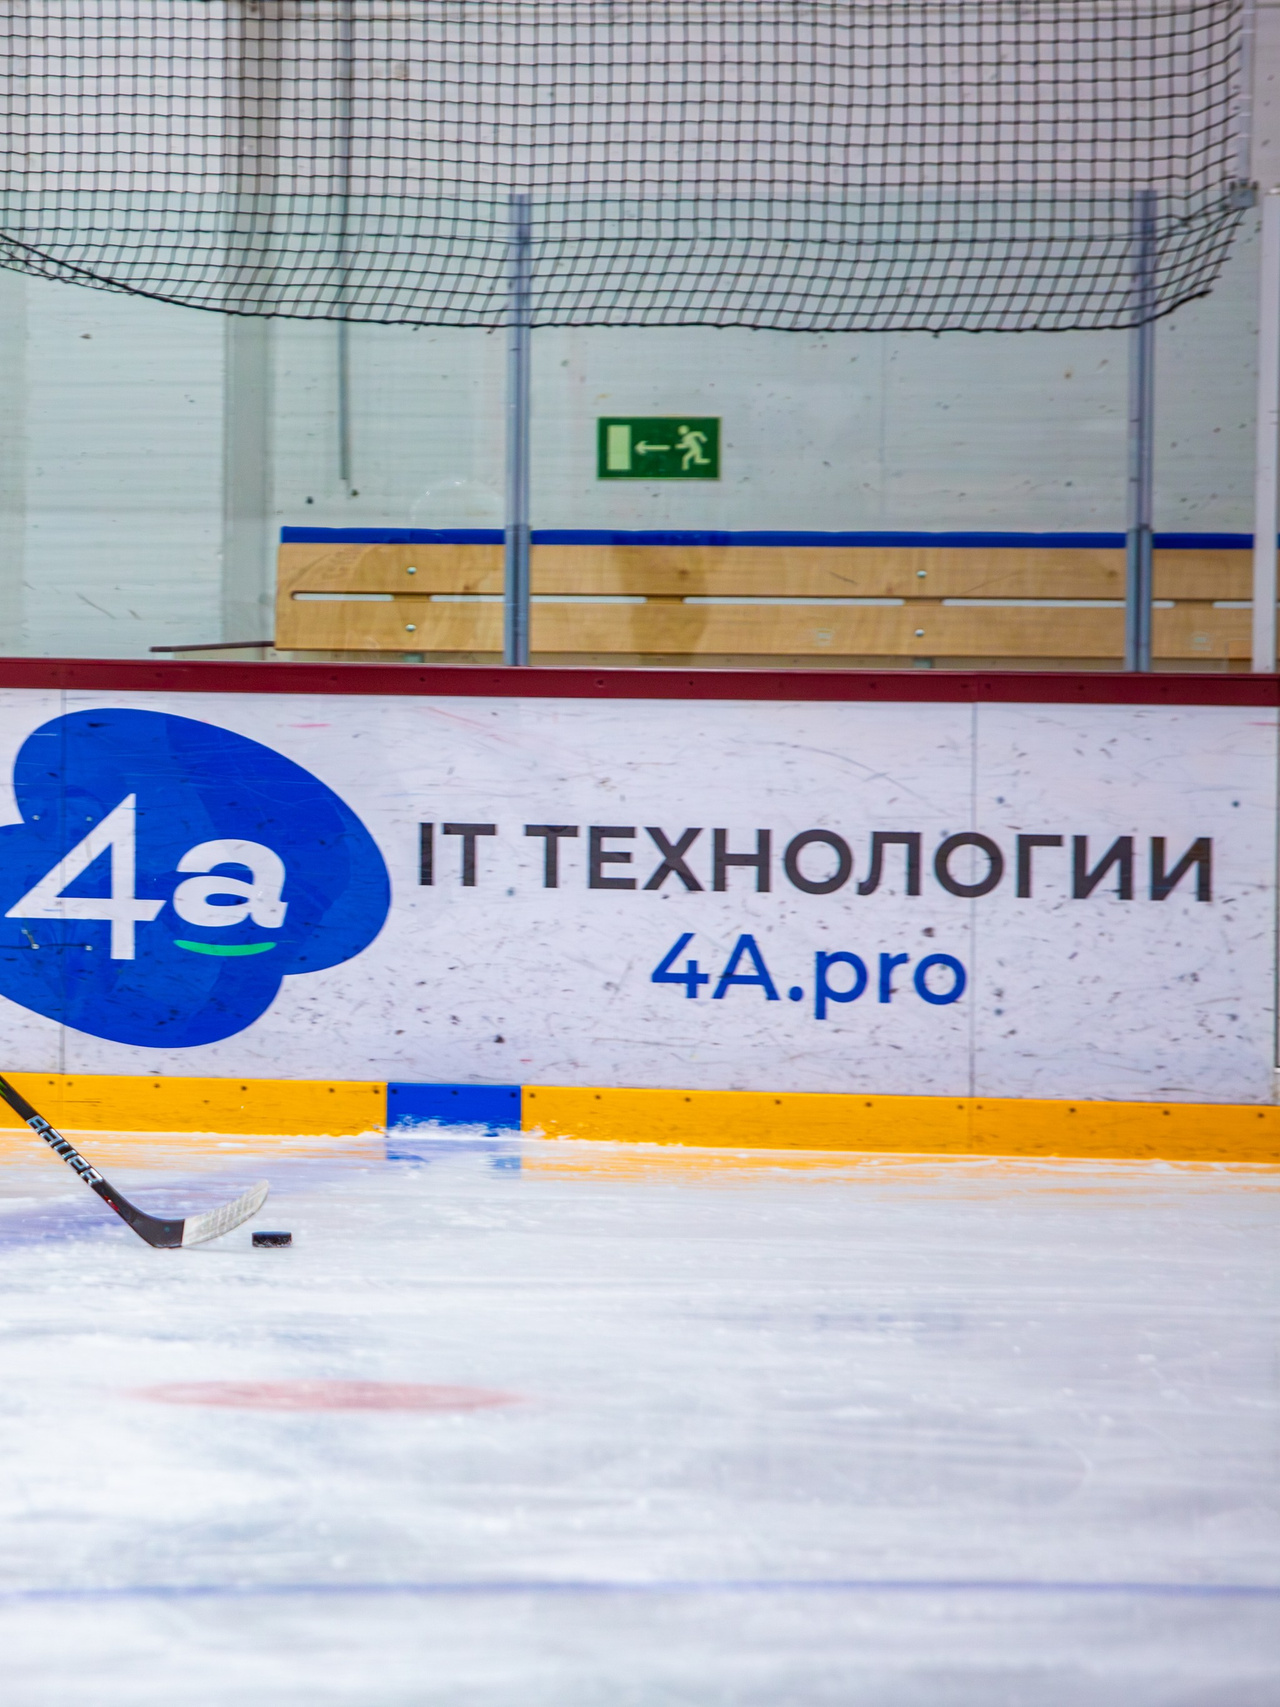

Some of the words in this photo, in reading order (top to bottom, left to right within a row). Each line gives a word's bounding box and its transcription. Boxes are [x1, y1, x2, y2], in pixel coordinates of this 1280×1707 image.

[5, 794, 289, 960] 4a
[419, 822, 497, 887] IT
[525, 824, 1213, 903] ТЕХНОЛОГИИ
[651, 932, 967, 1021] 4A.pro
[26, 1114, 103, 1187] BAUER
